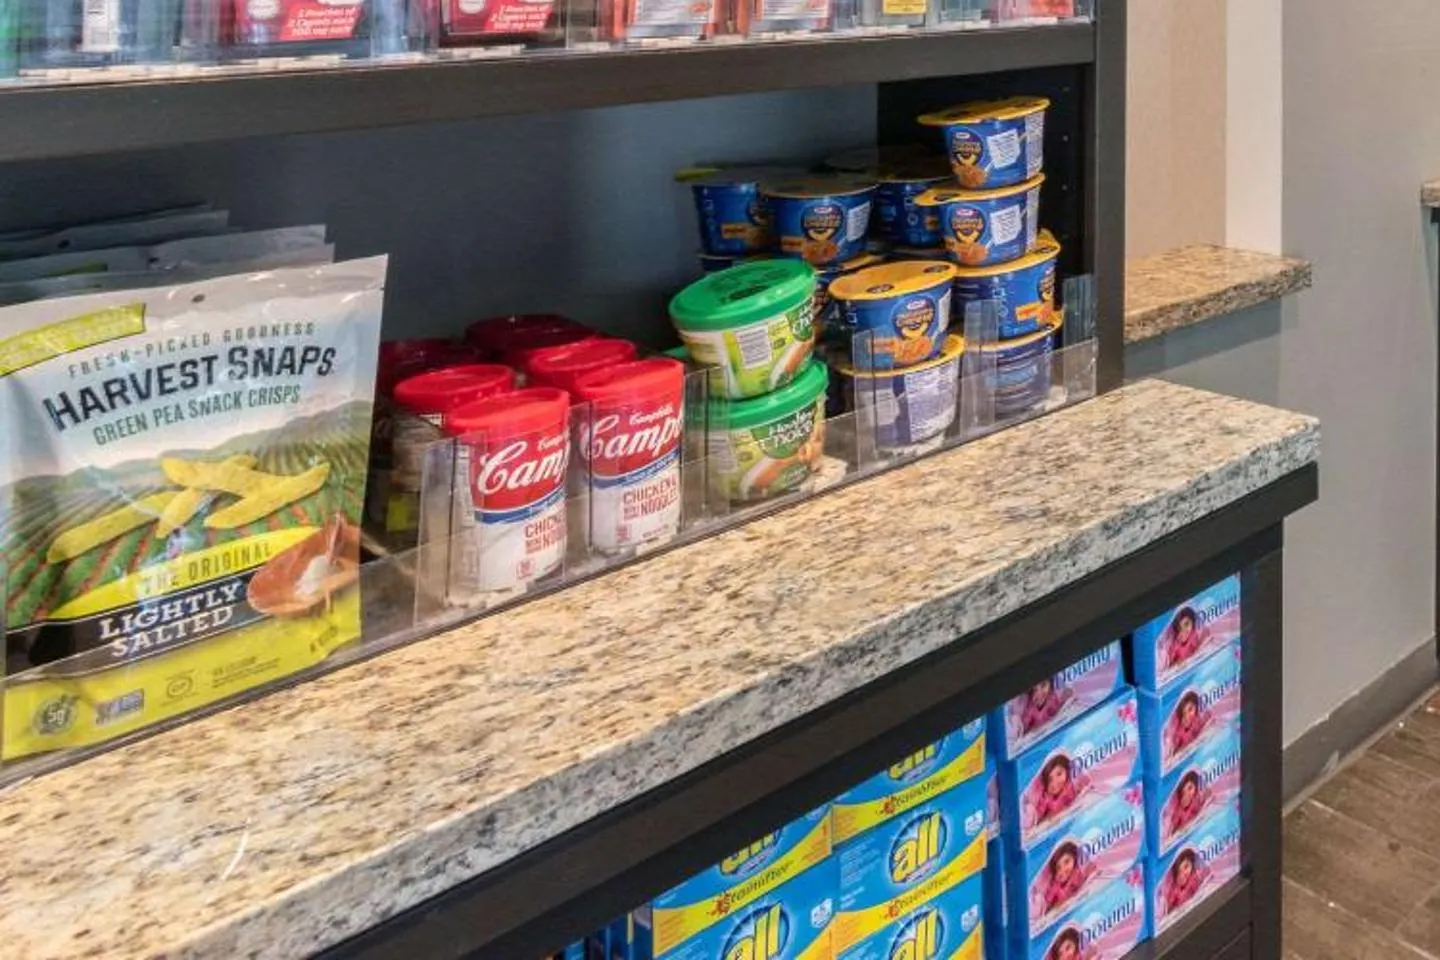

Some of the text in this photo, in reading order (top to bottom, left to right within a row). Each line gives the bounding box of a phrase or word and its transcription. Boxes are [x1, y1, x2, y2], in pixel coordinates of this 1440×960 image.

[222, 321, 317, 343] GOODNESS
[43, 344, 337, 432] HARVEST SNAPS
[92, 385, 302, 446] GREEN PEA SNACK CRISPS
[188, 543, 272, 582] ORIGINAL
[99, 580, 244, 640] LIGHTLY
[110, 605, 235, 658] SALTED
[1071, 732, 1128, 778] Downy
[891, 810, 940, 883] all
[1079, 815, 1136, 866] Downy
[1079, 898, 1136, 950] Downy
